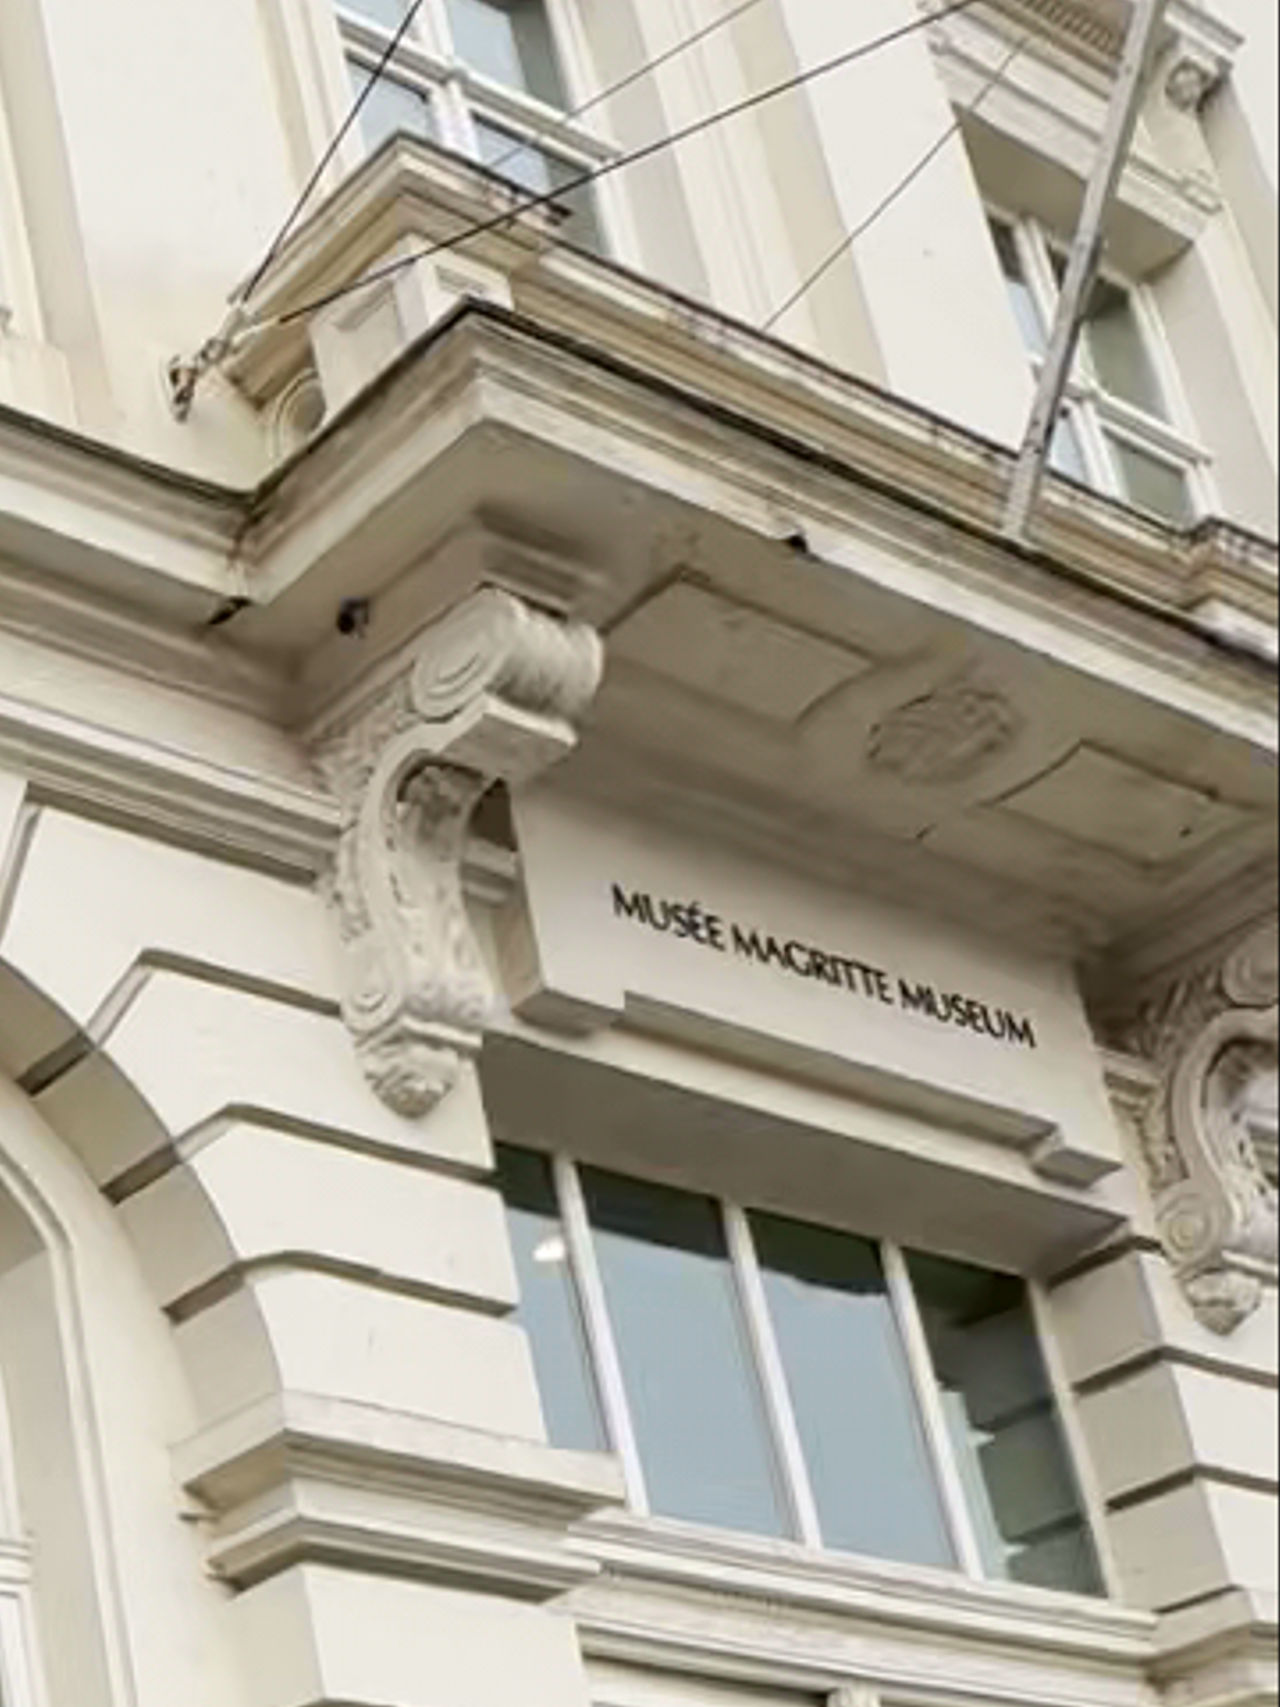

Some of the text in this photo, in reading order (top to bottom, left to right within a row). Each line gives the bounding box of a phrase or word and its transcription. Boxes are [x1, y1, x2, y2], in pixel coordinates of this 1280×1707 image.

[612, 882, 1037, 1049] MUSÉE MAGRITTE MUSEUM
